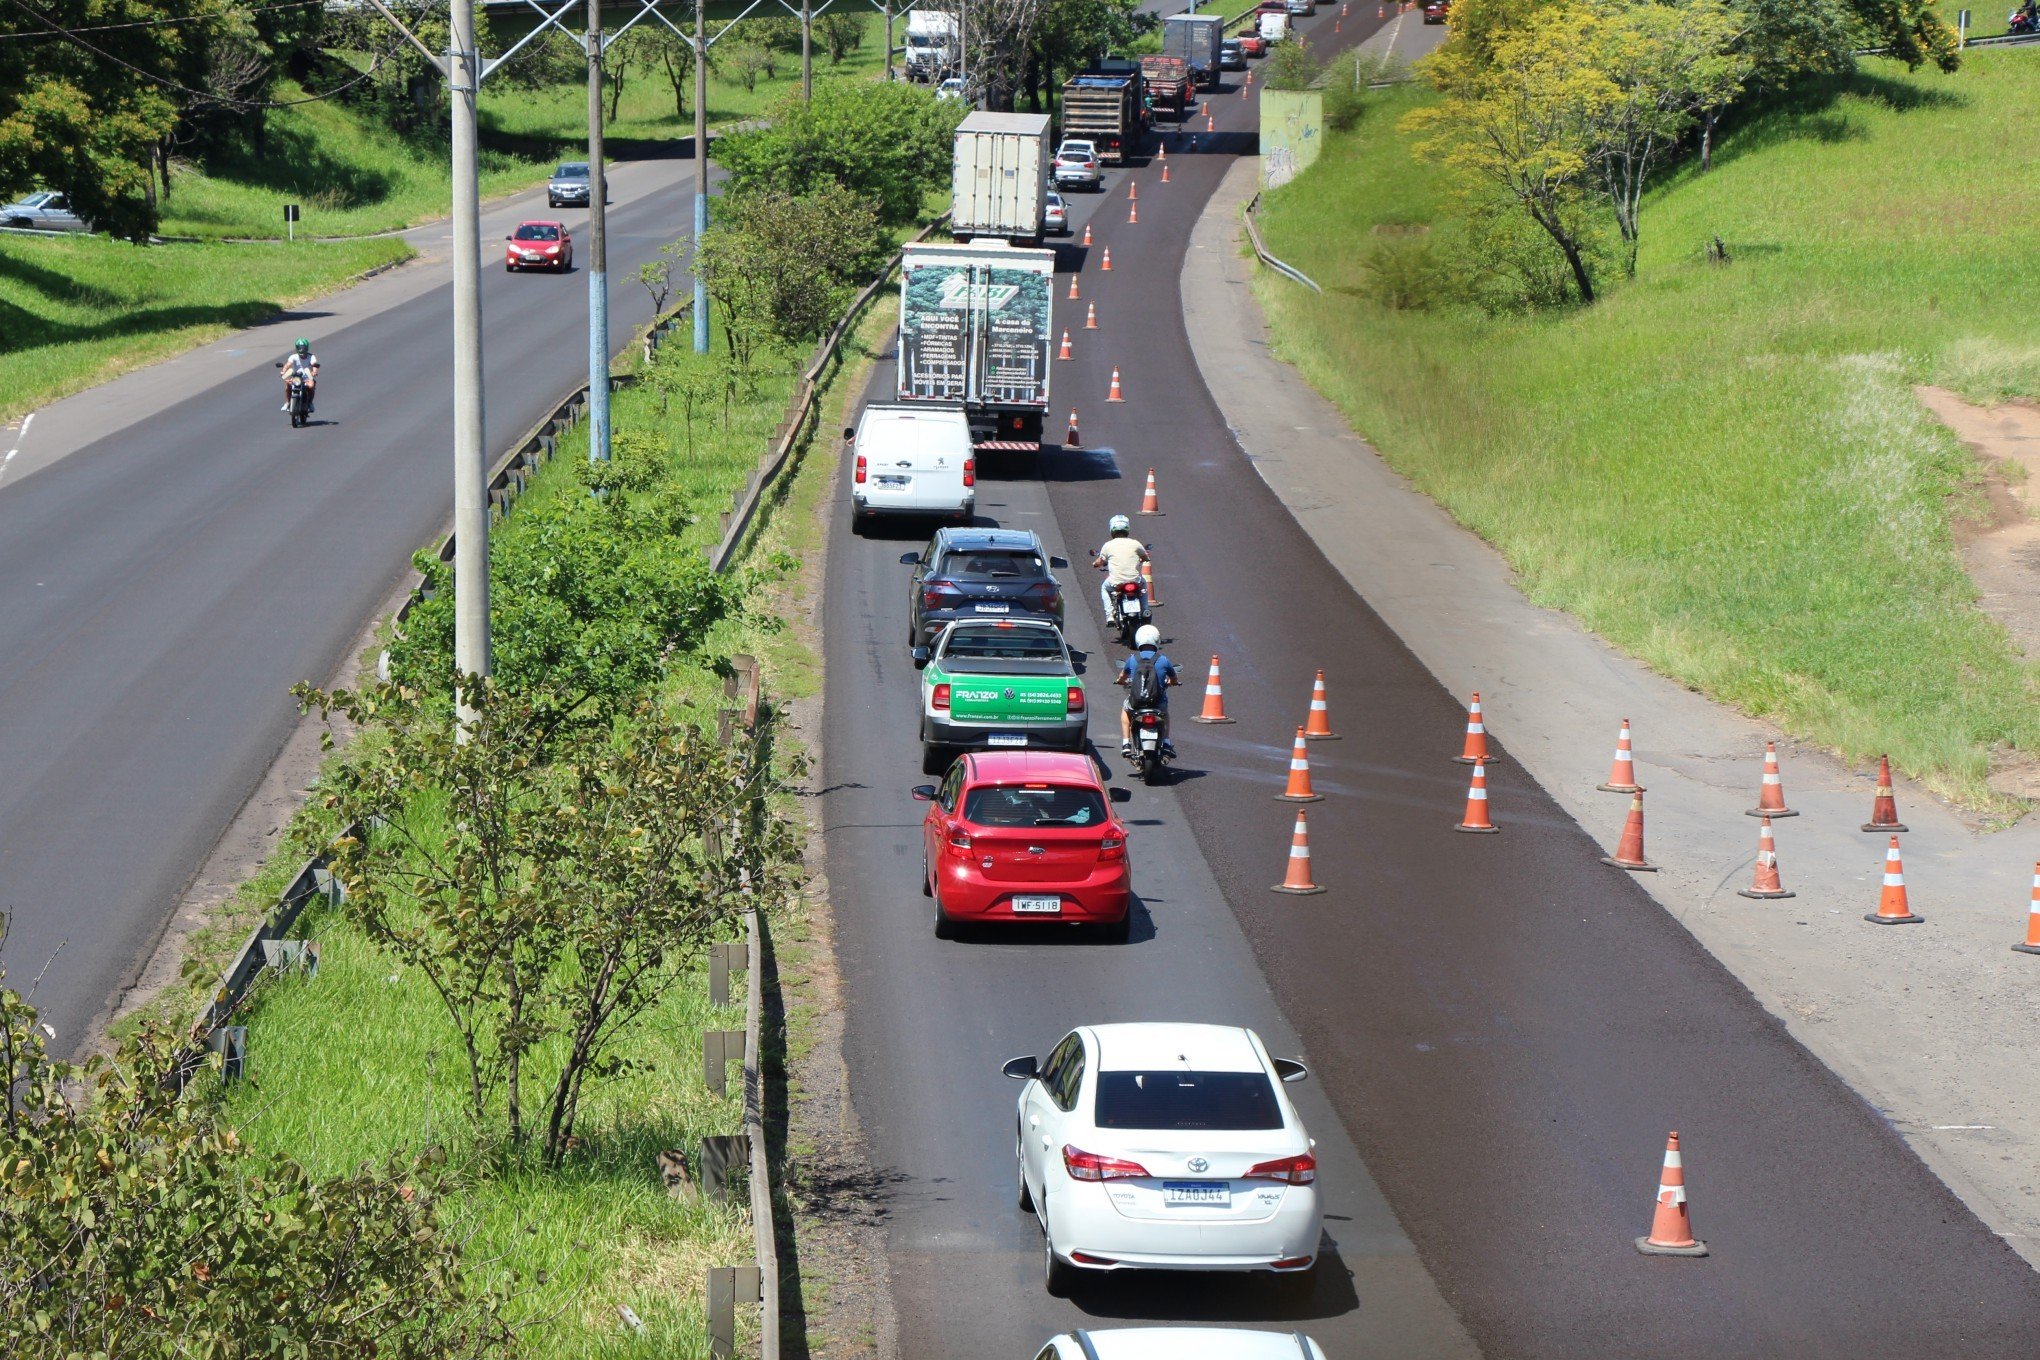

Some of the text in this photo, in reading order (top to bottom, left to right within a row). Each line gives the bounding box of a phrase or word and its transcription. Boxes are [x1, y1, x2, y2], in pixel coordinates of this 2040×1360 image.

[991, 326, 1033, 334] Marceneiro
[955, 691, 998, 699] FRANZOI
[1170, 1188, 1223, 1201] IZA0J44
